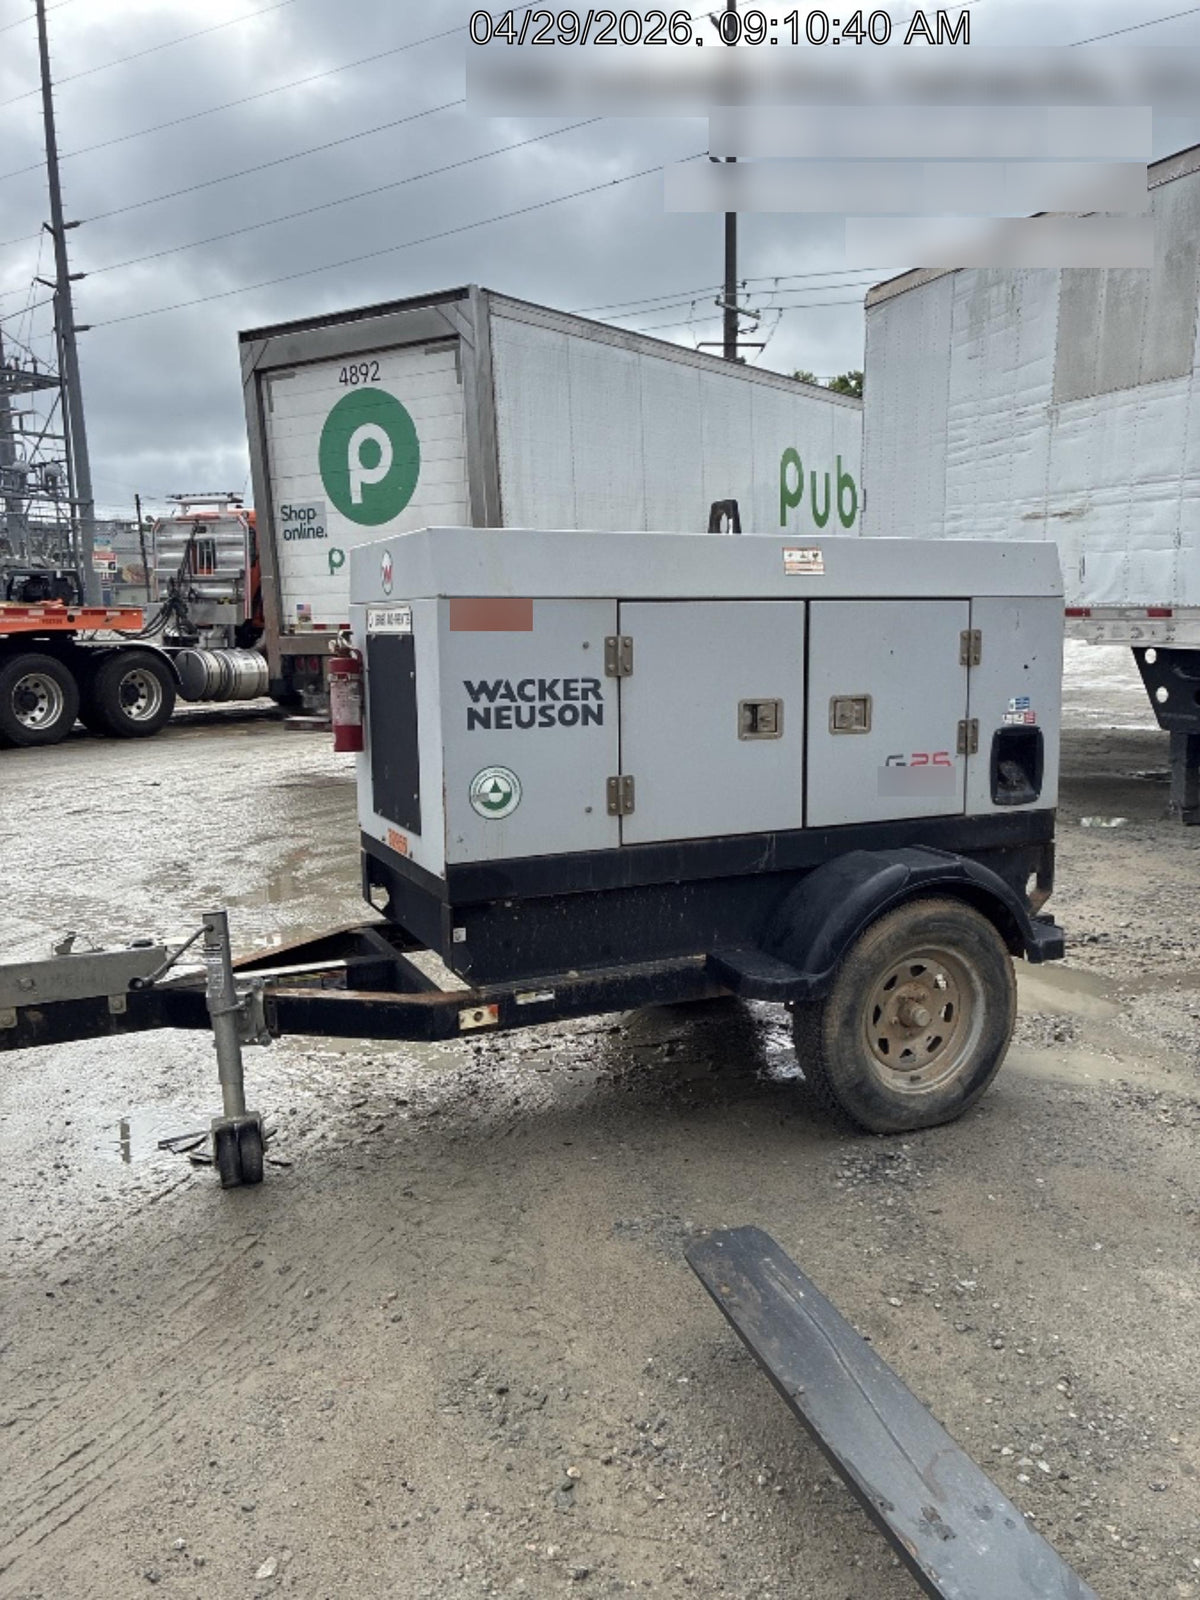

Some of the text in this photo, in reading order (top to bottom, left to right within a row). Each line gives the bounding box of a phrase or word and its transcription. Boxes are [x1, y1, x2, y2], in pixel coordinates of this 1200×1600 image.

[339, 361, 381, 386] 4892
[280, 504, 317, 525] Shop
[283, 522, 328, 541] online.
[462, 678, 604, 703] WACKER
[467, 703, 604, 731] NEUSON
